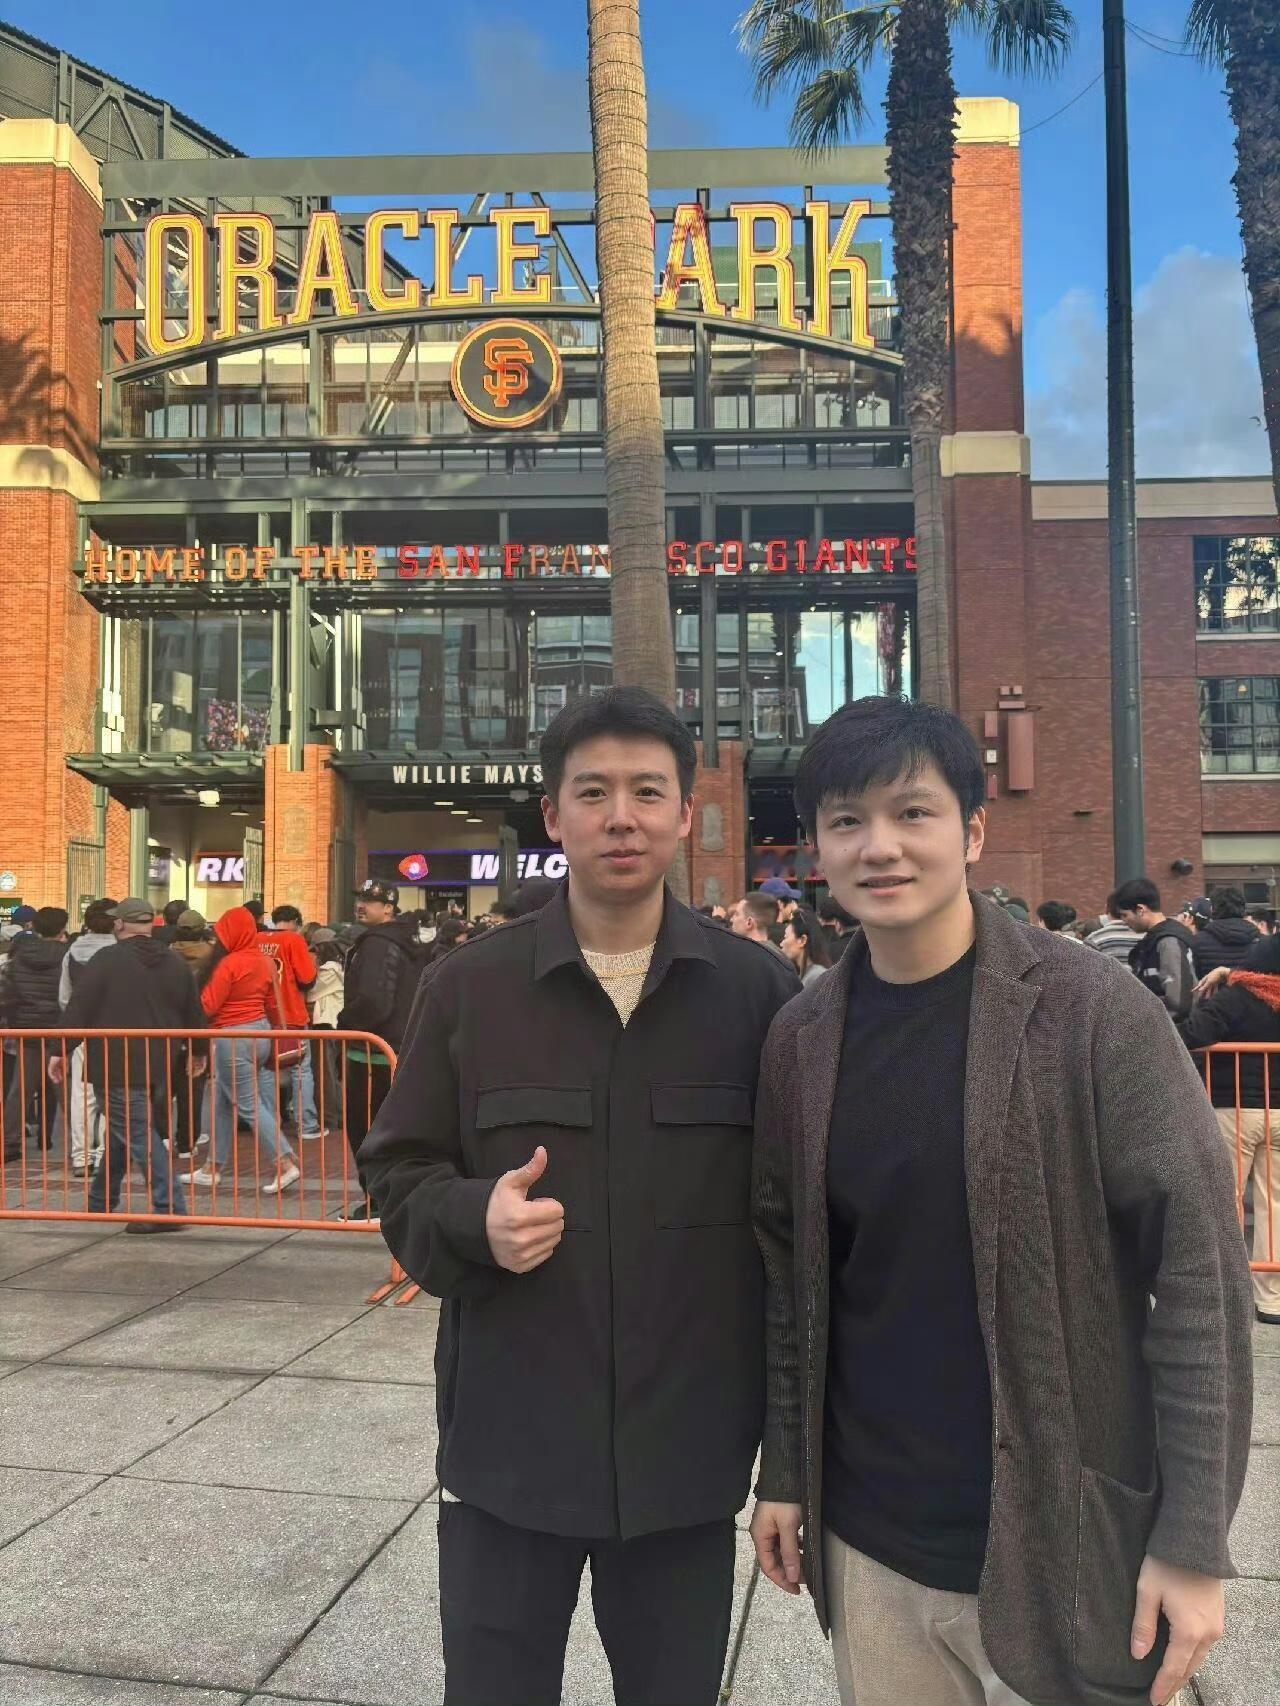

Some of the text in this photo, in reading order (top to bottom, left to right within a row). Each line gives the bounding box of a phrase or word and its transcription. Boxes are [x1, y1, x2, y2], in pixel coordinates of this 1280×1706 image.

[145, 199, 876, 355] ORACLE ARK
[84, 537, 917, 582] HOME OF THE SAN FRANSCO GIANTS
[392, 764, 543, 784] WILLIE MAYS
